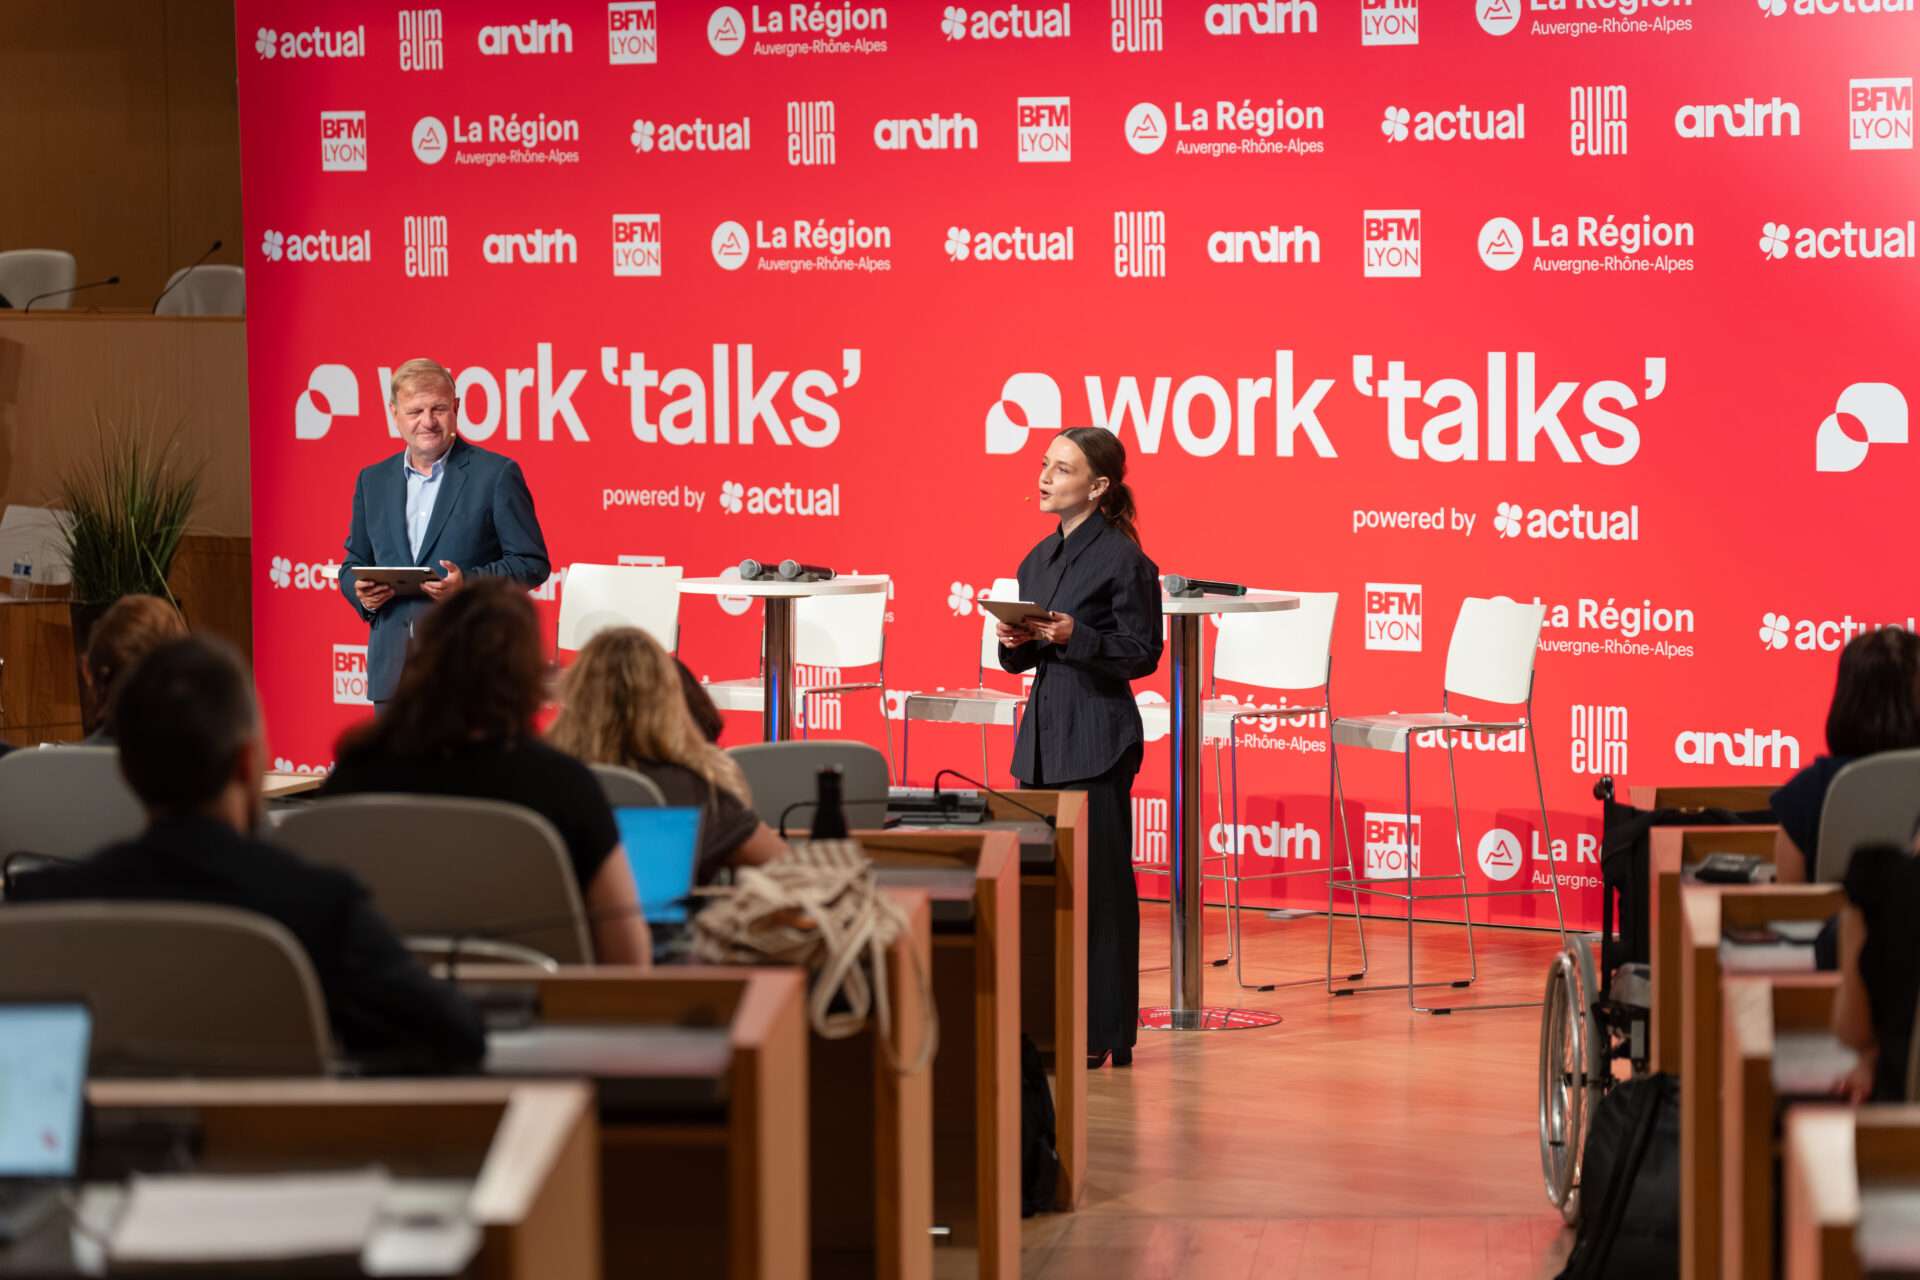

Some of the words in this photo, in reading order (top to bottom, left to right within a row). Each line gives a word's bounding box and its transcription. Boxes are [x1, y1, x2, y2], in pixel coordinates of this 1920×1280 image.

[610, 9, 655, 30] BFM
[752, 5, 783, 33] La
[790, 1, 887, 37] Région
[971, 3, 1071, 40] actual
[1205, 0, 1318, 35] andrh
[1364, 14, 1417, 35] LYON
[1531, 17, 1692, 37] Auvergne-Rhône-Alpes
[281, 25, 366, 58] actual
[478, 19, 573, 55] andrh
[610, 36, 656, 55] LYON
[753, 37, 888, 57] Auvergne-Rhône-Alpes
[1852, 86, 1912, 112] BFM
[323, 119, 365, 138] BFM
[454, 116, 482, 142] La
[488, 113, 579, 147] Région
[874, 113, 977, 149] andrh
[1019, 105, 1069, 126] BFM
[1175, 102, 1208, 130] La
[1216, 99, 1323, 136] Région
[1414, 104, 1525, 141] actual
[1675, 97, 1800, 138] andrh
[1853, 117, 1911, 139] LYON
[658, 117, 750, 151] actual
[1020, 132, 1069, 152] LYON
[1176, 138, 1324, 157] Auvergne-Rhône-Alpes
[323, 143, 366, 163] LYON
[455, 148, 580, 166] Auvergne-Rhône-Alpes
[614, 222, 659, 242] BFM
[757, 221, 787, 248] La
[794, 219, 891, 253] Région
[974, 227, 1074, 260] actual
[1208, 226, 1320, 262] andrh
[1366, 218, 1419, 240] BFM
[1533, 217, 1568, 247] La
[1577, 215, 1694, 253] Région
[1795, 221, 1916, 258] actual
[287, 230, 371, 262] actual
[483, 229, 577, 263] andrh
[615, 248, 660, 267] LYON
[1367, 247, 1419, 267] LYON
[757, 254, 891, 273] Auvergne-Rhône-Alpes
[1533, 254, 1693, 274] Auvergne-Rhône-Alpes
[1084, 350, 1338, 458] work
[603, 486, 679, 511] powered
[684, 486, 705, 512] by
[747, 483, 840, 516] actual
[1353, 508, 1444, 533] powered
[1451, 508, 1476, 536] by
[1527, 504, 1638, 540] actual
[295, 559, 341, 590] act
[1368, 592, 1421, 616] BFM
[1578, 598, 1694, 637] Région
[1369, 620, 1420, 641] LYON
[1675, 728, 1800, 769] andrh
[1366, 821, 1419, 845] BFM
[1532, 830, 1567, 861] La
[1367, 849, 1418, 870] LYON
